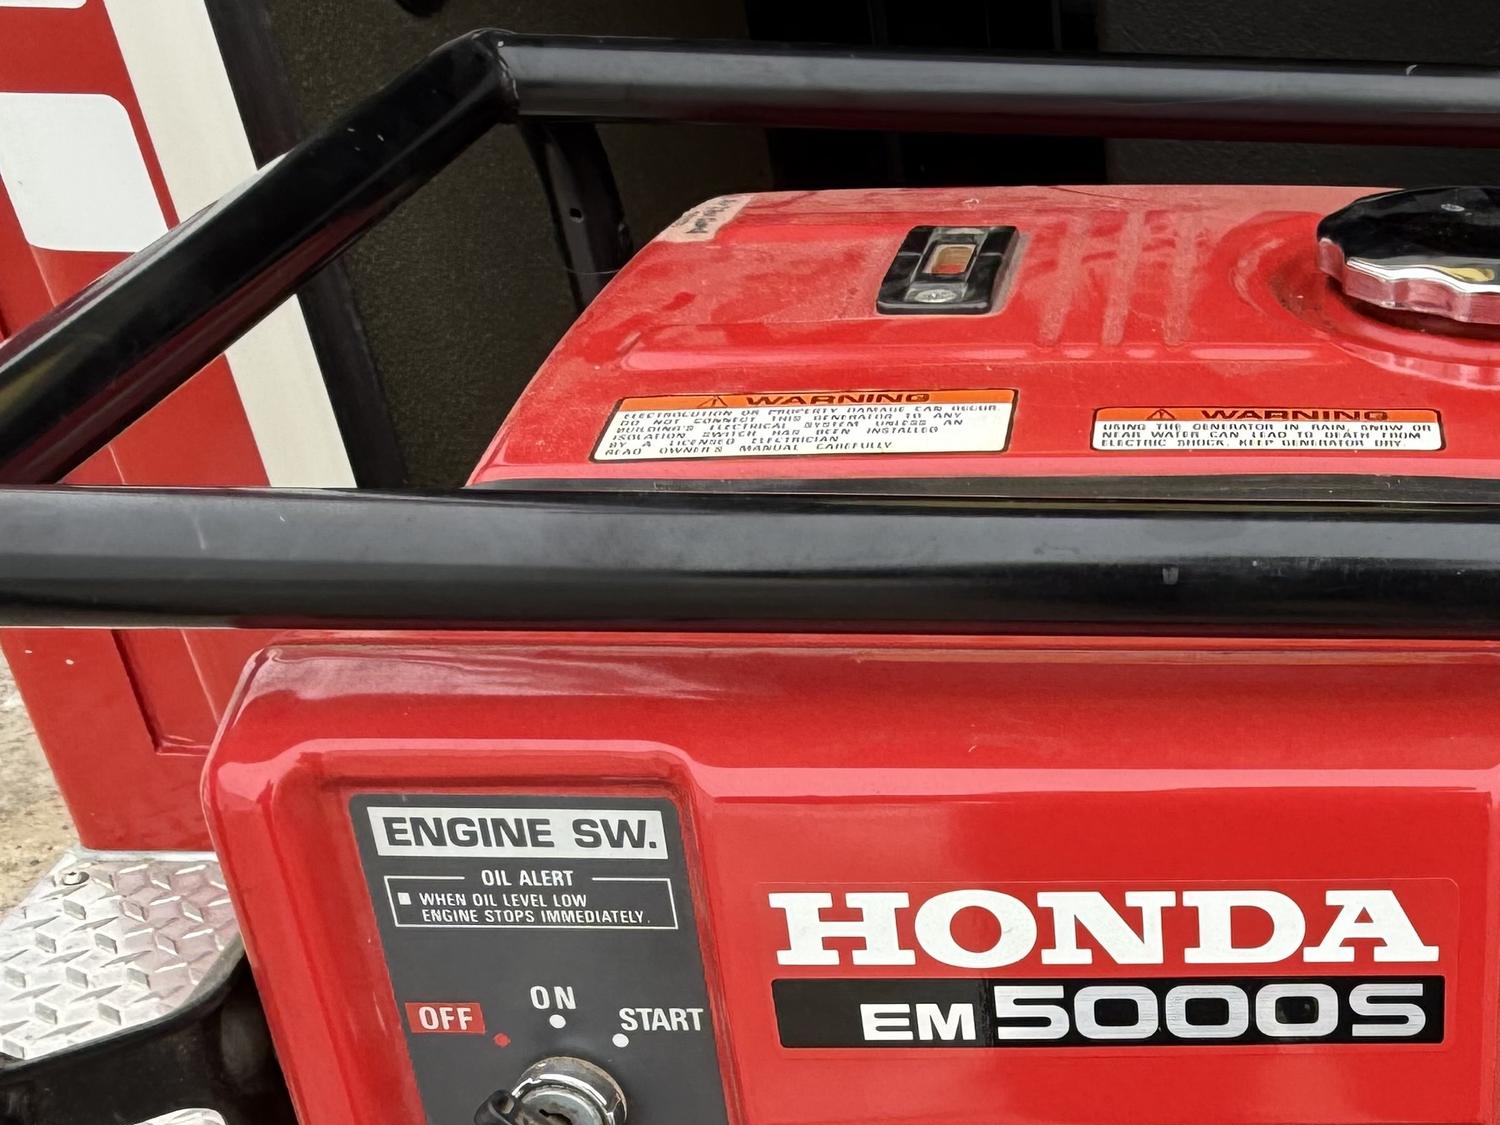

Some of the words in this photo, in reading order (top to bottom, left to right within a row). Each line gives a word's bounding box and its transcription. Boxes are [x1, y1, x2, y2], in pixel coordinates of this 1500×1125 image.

[746, 393, 930, 405] WARNING
[933, 412, 962, 420] ANY
[1201, 410, 1388, 421] WARNING
[1192, 423, 1273, 431] GENERATOR
[1284, 423, 1299, 431] IN
[1210, 431, 1240, 439] CAN
[1101, 439, 1167, 447] ELECTRIC
[382, 816, 555, 848] ENGINE
[573, 817, 658, 849] SW.
[481, 869, 512, 886] OIL
[519, 870, 574, 887] ALERT
[419, 892, 467, 907] WHEN
[473, 893, 498, 907] OIL
[503, 894, 548, 908] LEVEL
[553, 894, 587, 908] LOW
[422, 909, 479, 923] ENGINE
[485, 909, 535, 924] STOPS
[768, 889, 1440, 969] HONDA
[530, 985, 577, 1010] ON
[418, 1006, 473, 1031] OFF
[619, 1007, 704, 1032] START
[860, 1003, 976, 1042] EM
[997, 982, 1427, 1039] 5000S
